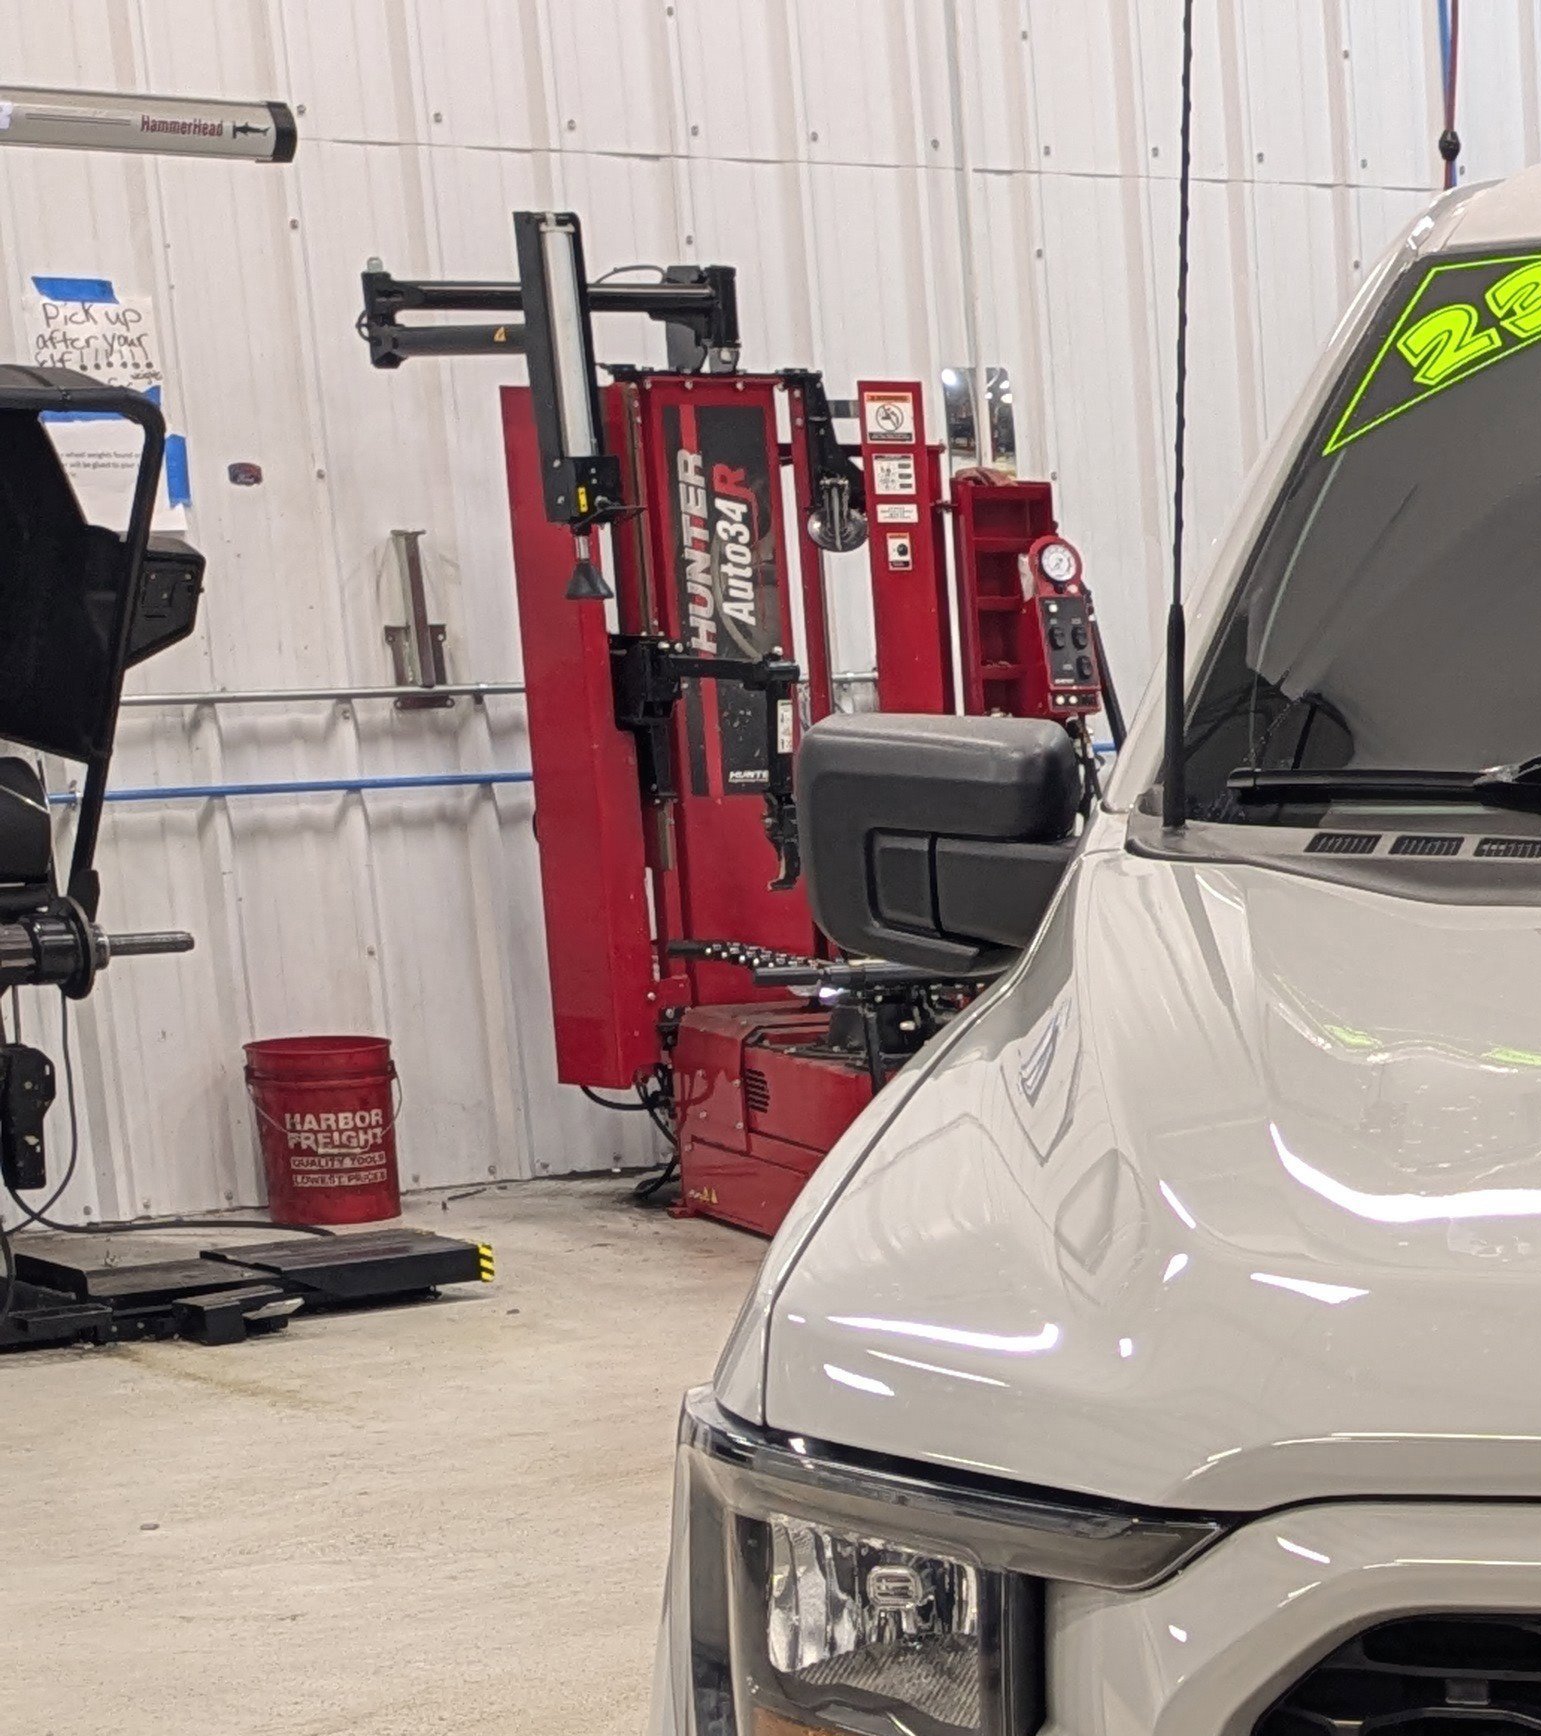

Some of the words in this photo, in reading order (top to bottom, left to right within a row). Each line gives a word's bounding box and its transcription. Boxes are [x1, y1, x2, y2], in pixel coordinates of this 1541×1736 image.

[140, 114, 223, 137] HammerHead
[42, 302, 98, 328] Pick
[105, 308, 142, 331] up
[36, 329, 98, 350] after
[677, 448, 718, 656] HUNTER
[713, 462, 758, 627] Auto34R
[729, 770, 768, 779] HUNTE
[284, 1108, 383, 1131] HARBOR
[286, 1127, 383, 1152] FREIGHT
